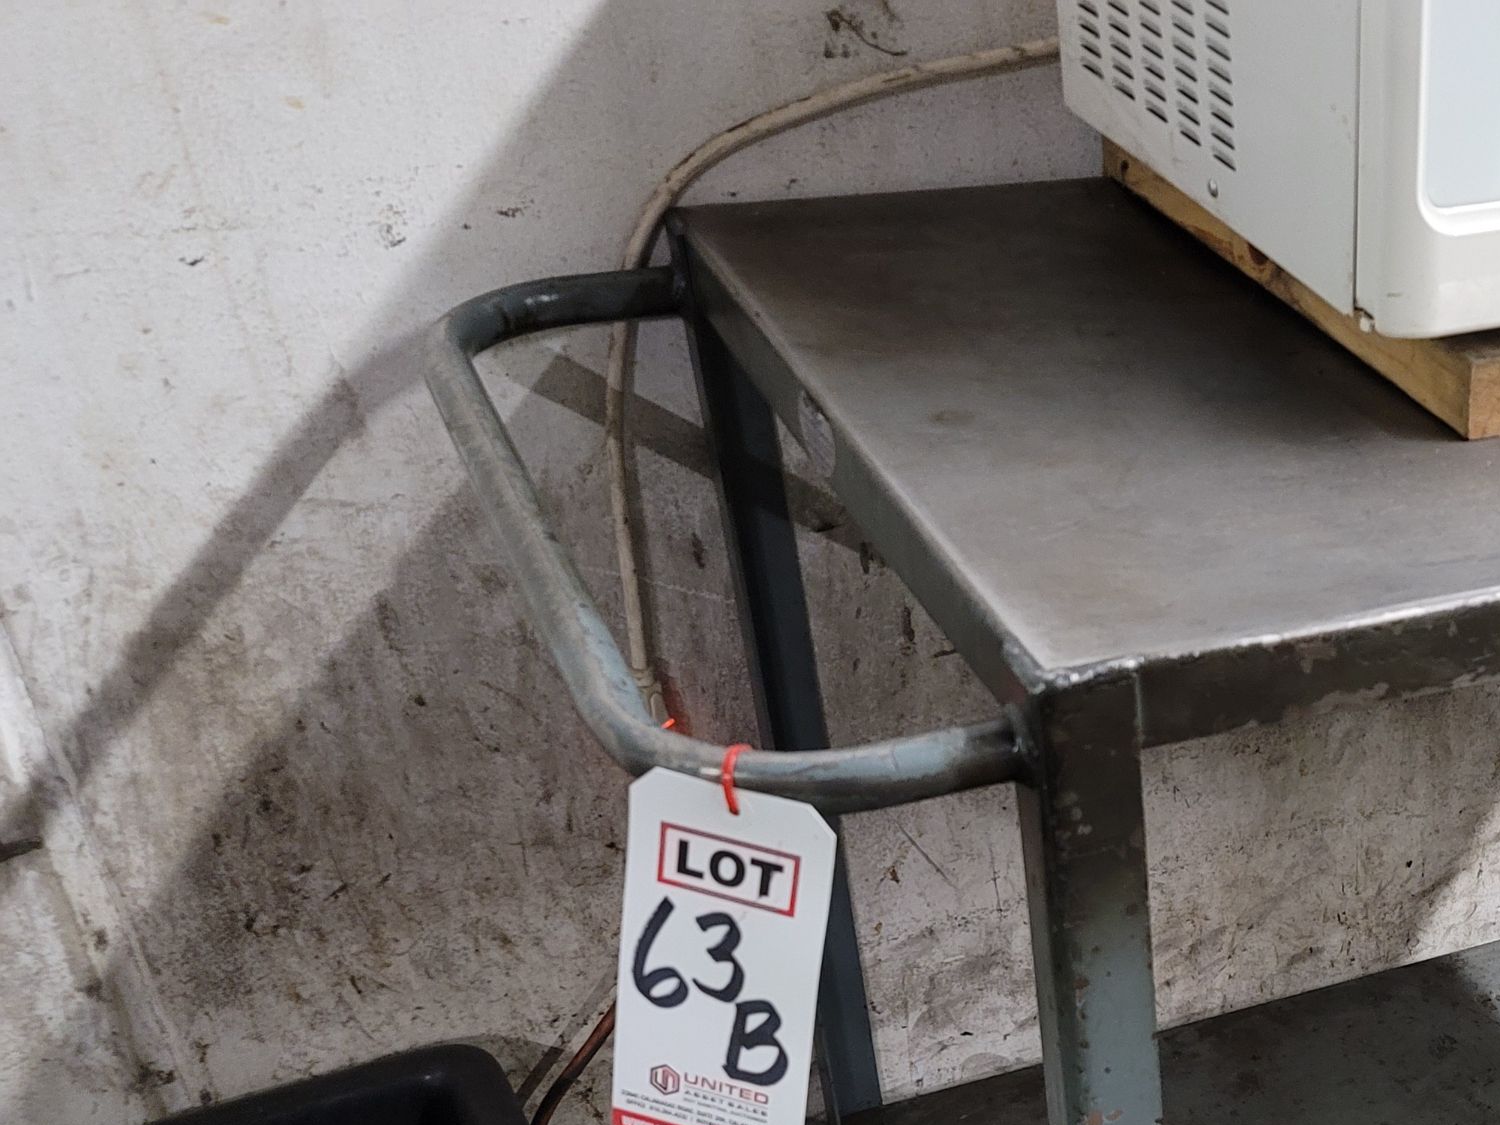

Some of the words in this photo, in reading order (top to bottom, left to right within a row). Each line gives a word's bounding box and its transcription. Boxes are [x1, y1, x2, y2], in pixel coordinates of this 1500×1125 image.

[675, 840, 784, 898] LOT
[631, 896, 744, 1009] 63
[722, 999, 789, 1086] B
[683, 1072, 769, 1105] UNITED
